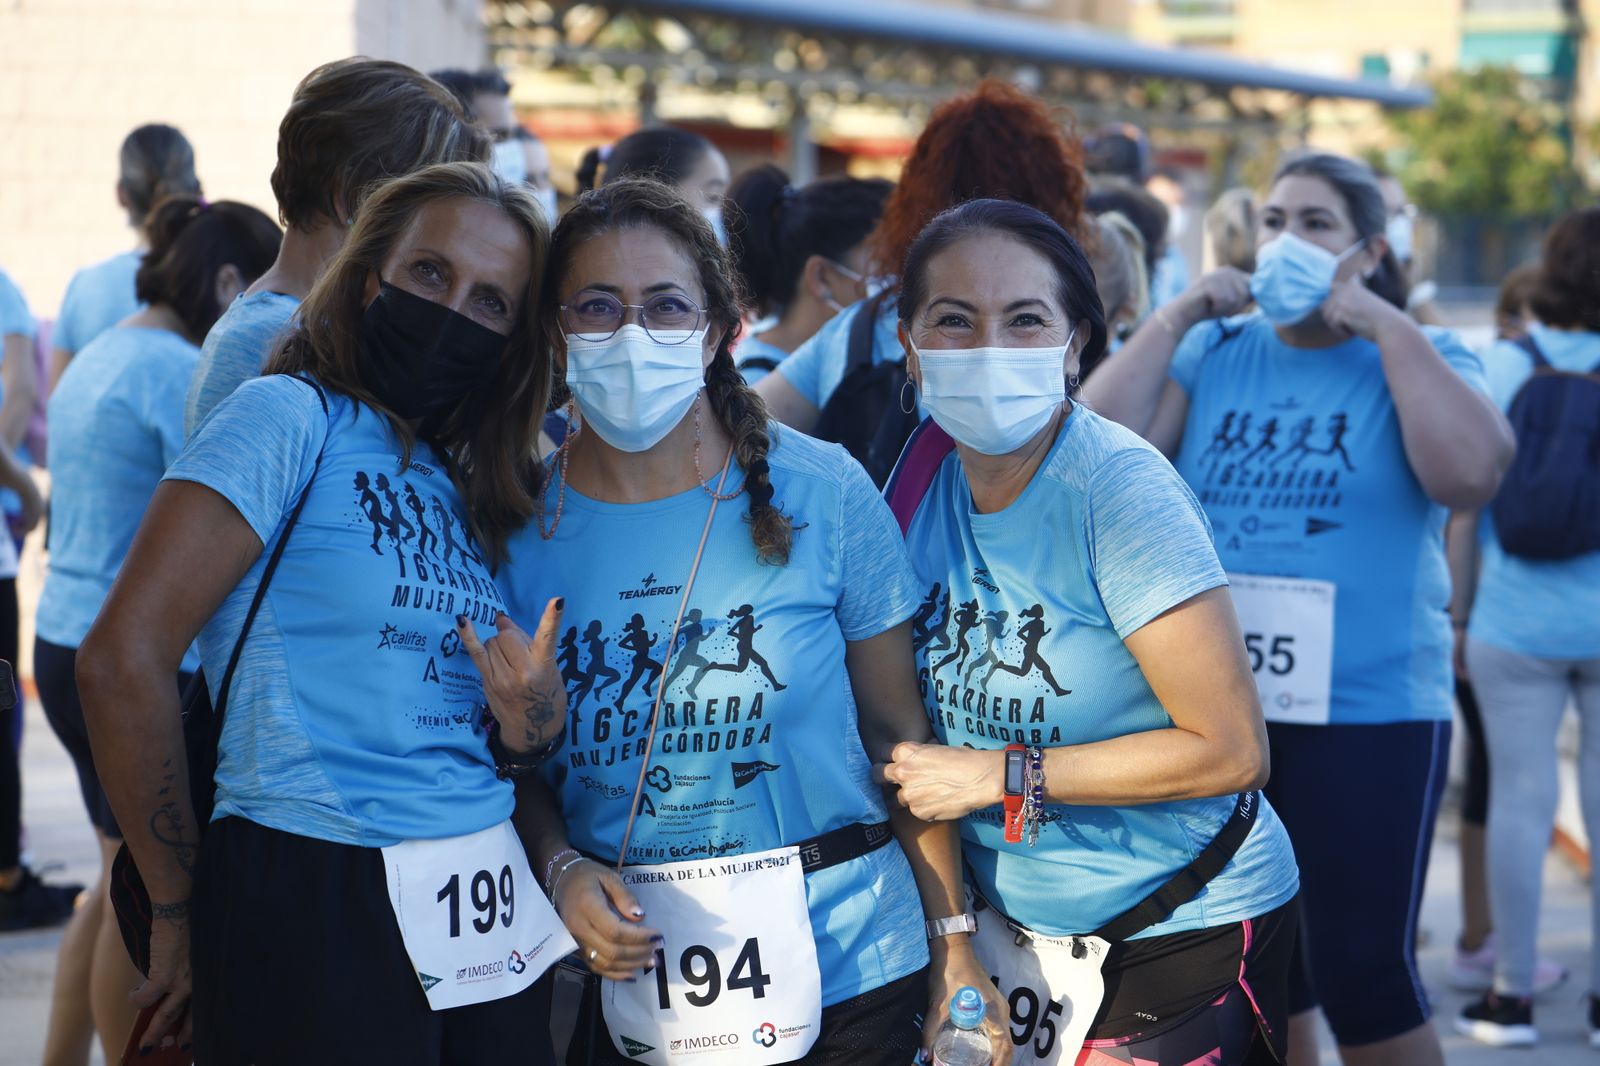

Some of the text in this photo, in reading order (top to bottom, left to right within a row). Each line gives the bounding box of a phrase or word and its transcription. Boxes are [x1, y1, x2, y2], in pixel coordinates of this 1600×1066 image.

[391, 584, 455, 615] MUJER
[618, 585, 682, 600] TEAMERGY
[391, 631, 427, 647] califas
[935, 679, 1046, 723] CARRERA
[417, 715, 450, 727] PREMIO
[622, 692, 764, 738] CARRERA
[965, 713, 1062, 744] CÓRDOBA
[570, 722, 772, 769] MUJER CÓRDOBA
[674, 780, 696, 788] cajasur
[659, 798, 735, 812] Junta de Andalucía
[628, 846, 665, 858] PREMIO
[681, 844, 707, 858] Corte
[623, 871, 675, 886] CARRERA
[677, 869, 695, 881] DE
[698, 867, 716, 879] LA
[720, 859, 764, 876] MUJER
[437, 864, 515, 938] 199
[468, 960, 504, 978] IMDECO
[643, 936, 771, 1010] 194
[778, 1023, 812, 1034] fundaciones
[779, 1032, 801, 1040] cajasur
[684, 1033, 739, 1049] IMDECO
